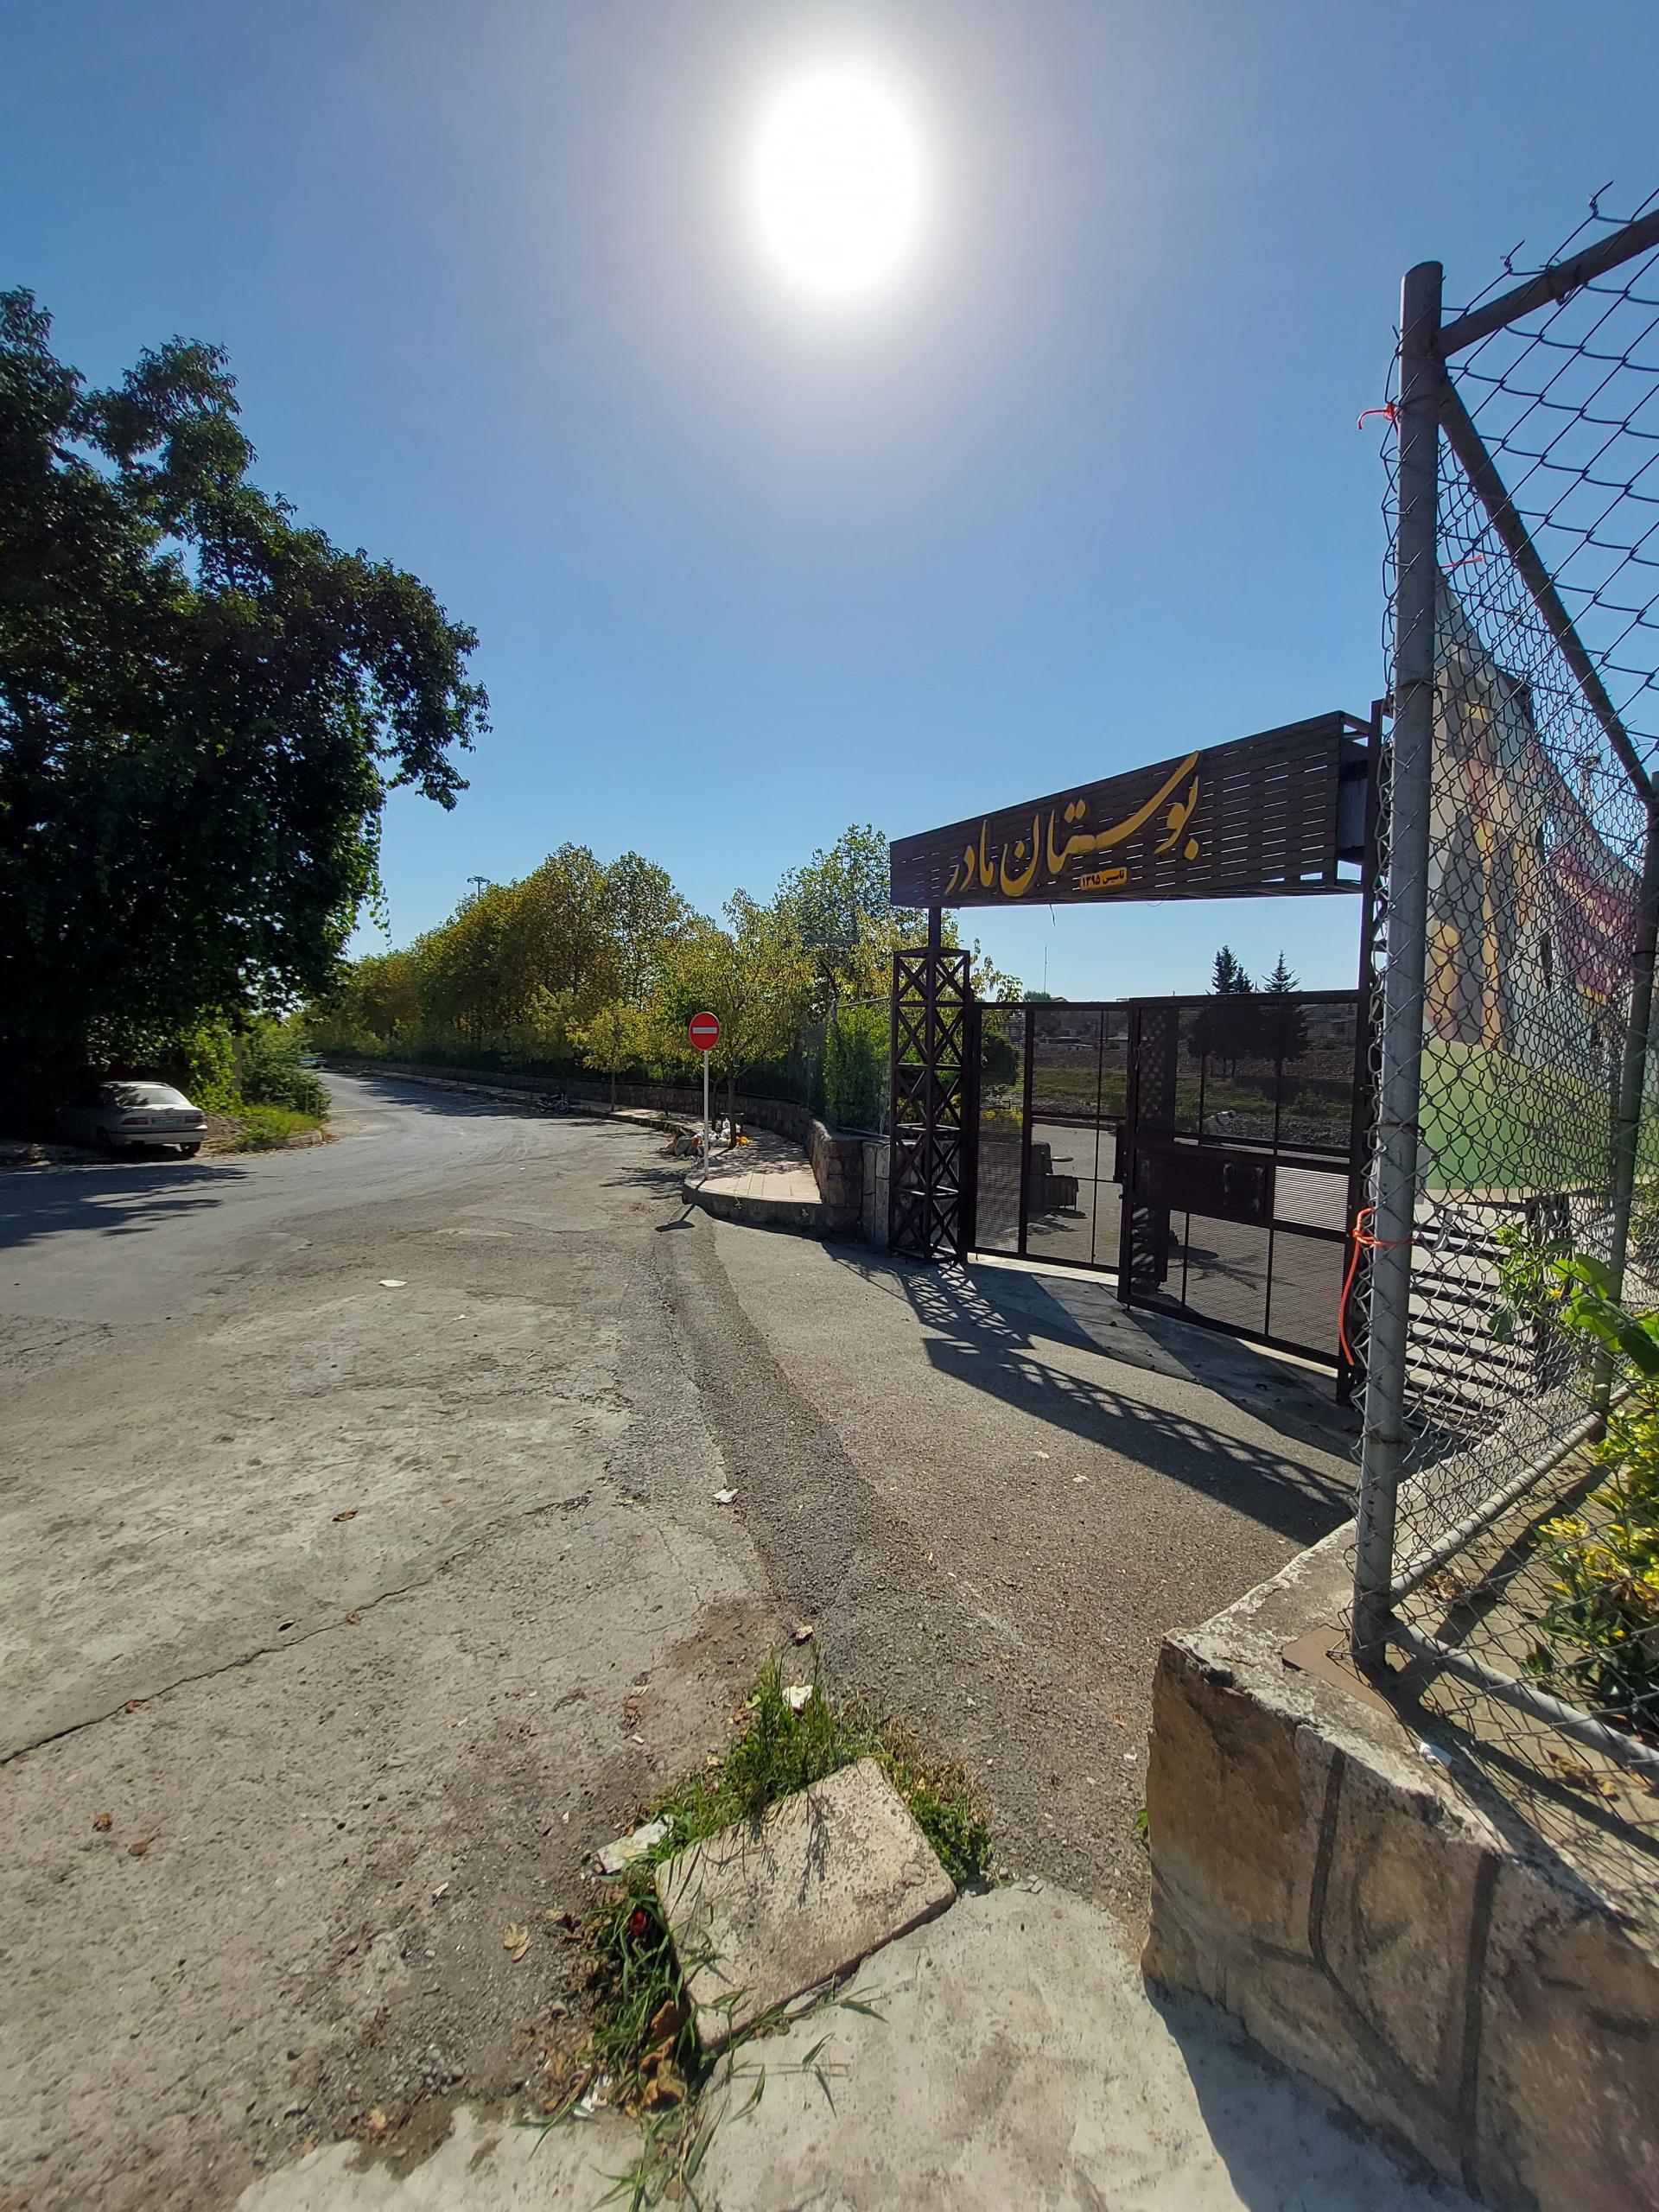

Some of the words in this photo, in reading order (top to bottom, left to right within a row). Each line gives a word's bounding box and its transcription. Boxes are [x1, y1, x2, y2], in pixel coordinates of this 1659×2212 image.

[944, 819, 994, 896] مادر
[1000, 750, 1199, 897] بوستان
[1082, 874, 1101, 887] ۱۳۹۵
